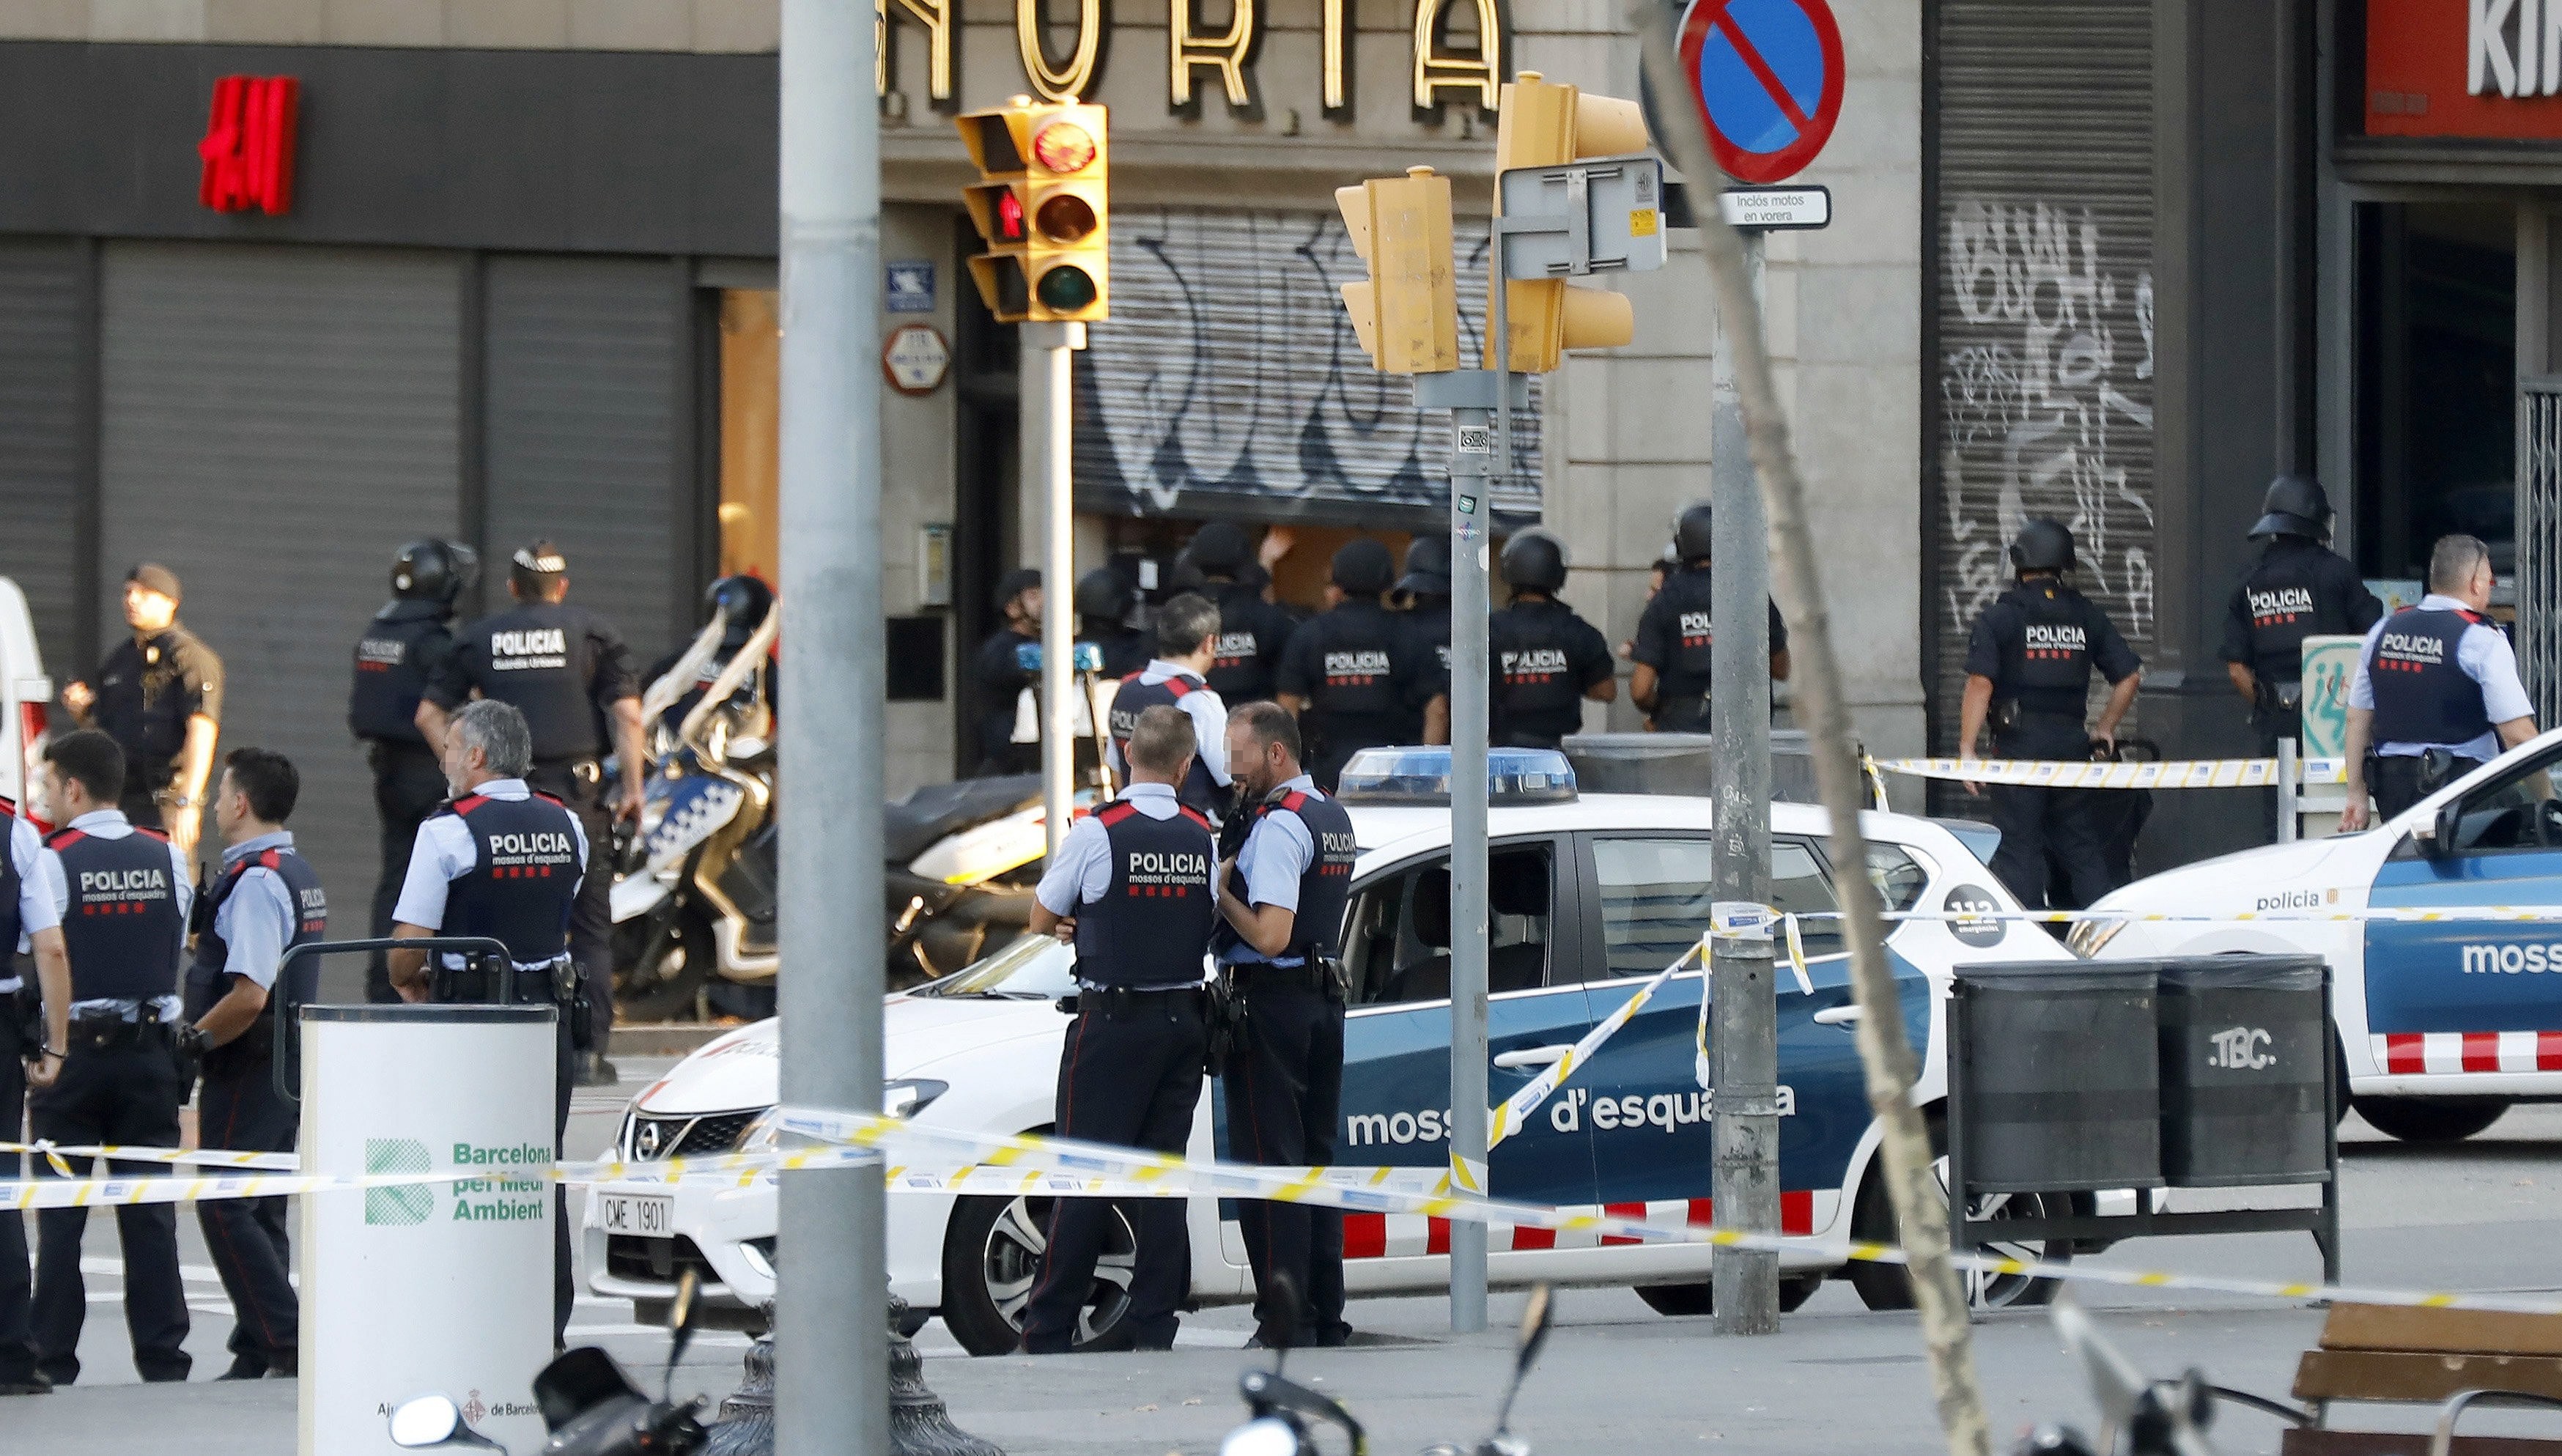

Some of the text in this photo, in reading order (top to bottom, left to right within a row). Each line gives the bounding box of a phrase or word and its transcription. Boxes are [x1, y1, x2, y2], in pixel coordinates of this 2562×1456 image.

[1771, 195, 1804, 207] motos
[1744, 211, 1793, 222] en vorera
[2246, 585, 2312, 613] POLICIA
[491, 628, 566, 657] POLICIA
[2025, 624, 2086, 644] POLICIA
[2382, 632, 2444, 657] POLICIA
[1324, 651, 1391, 668] POLICIA
[489, 832, 572, 855] POLICIA
[1129, 851, 1206, 874] POLICIA
[80, 868, 166, 892] POLICIA
[1129, 874, 1162, 884] mossos
[2256, 890, 2319, 911] policia
[1951, 900, 1997, 925] 112
[451, 1200, 543, 1221] Ambient
[605, 1200, 664, 1231] CME 1901
[491, 1403, 504, 1416] de
